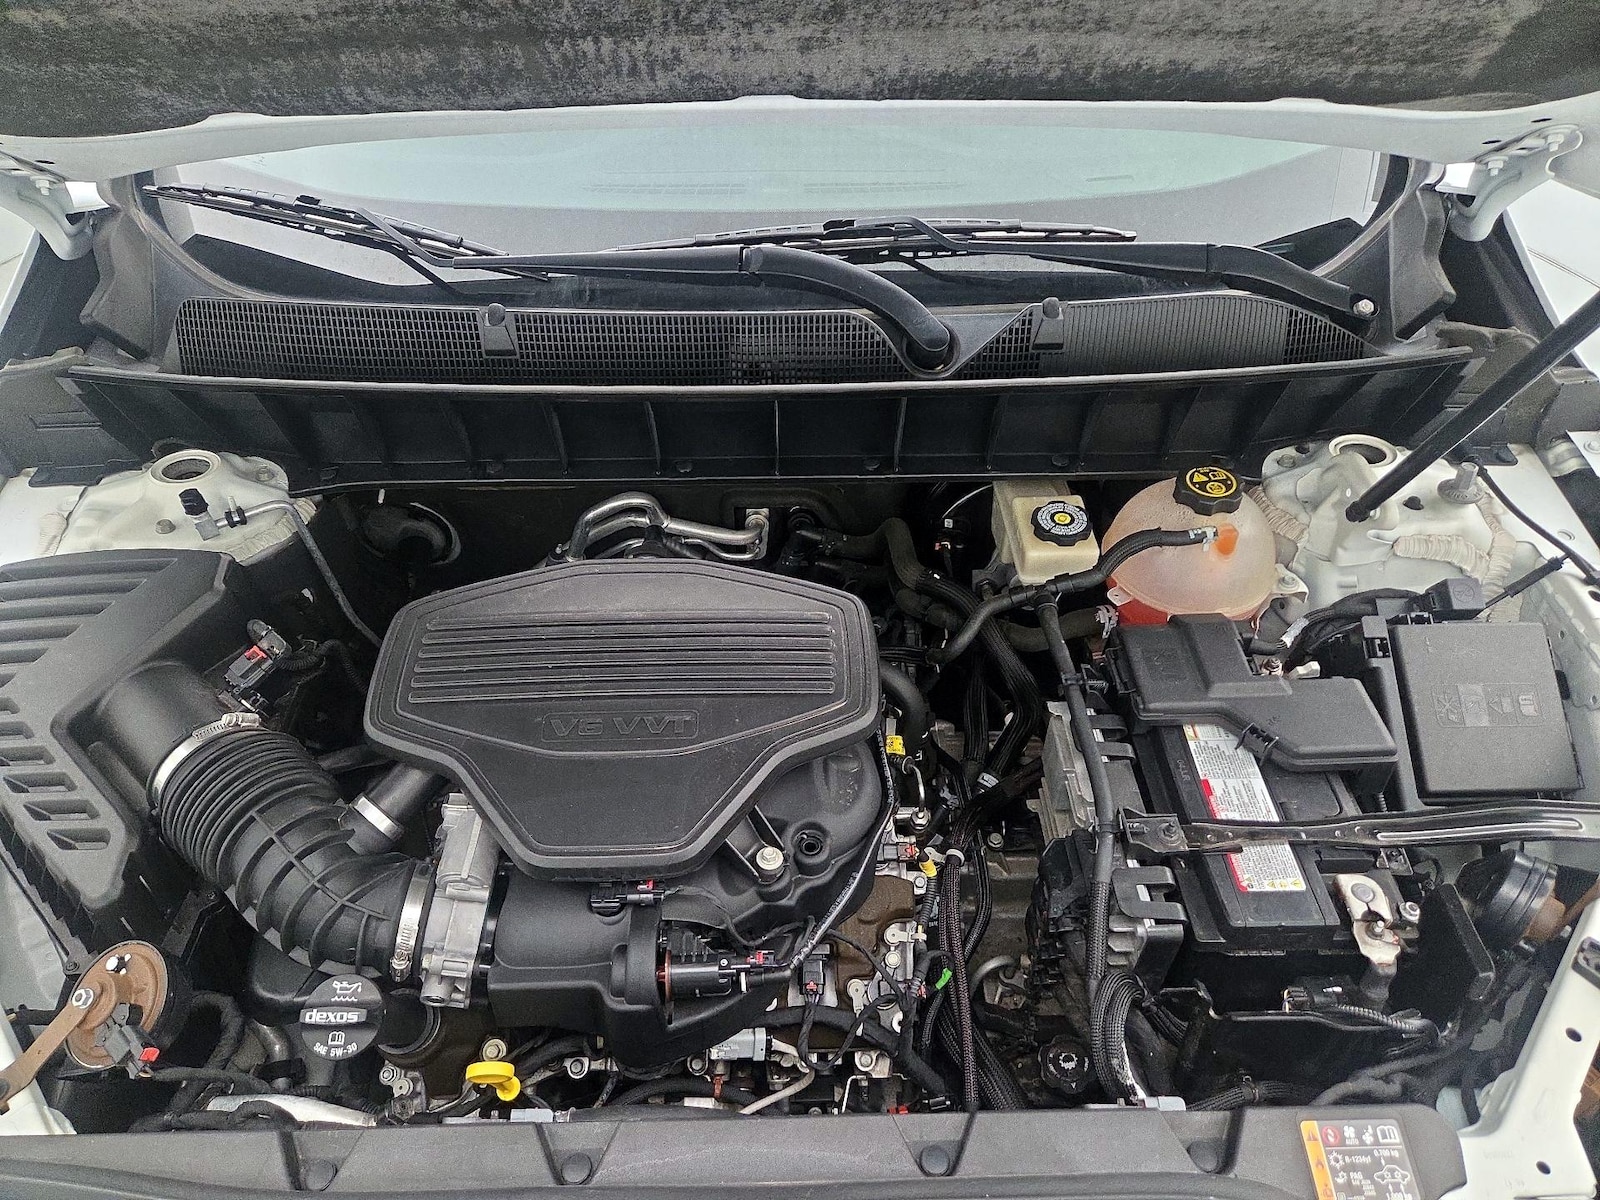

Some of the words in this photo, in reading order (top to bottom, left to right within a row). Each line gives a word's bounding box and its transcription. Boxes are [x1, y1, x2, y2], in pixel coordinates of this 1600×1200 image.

[550, 718, 603, 737] V6
[613, 715, 692, 735] VVT
[304, 1008, 360, 1023] dexos
[313, 1042, 329, 1055] SAE
[330, 1042, 358, 1057] 5W-30
